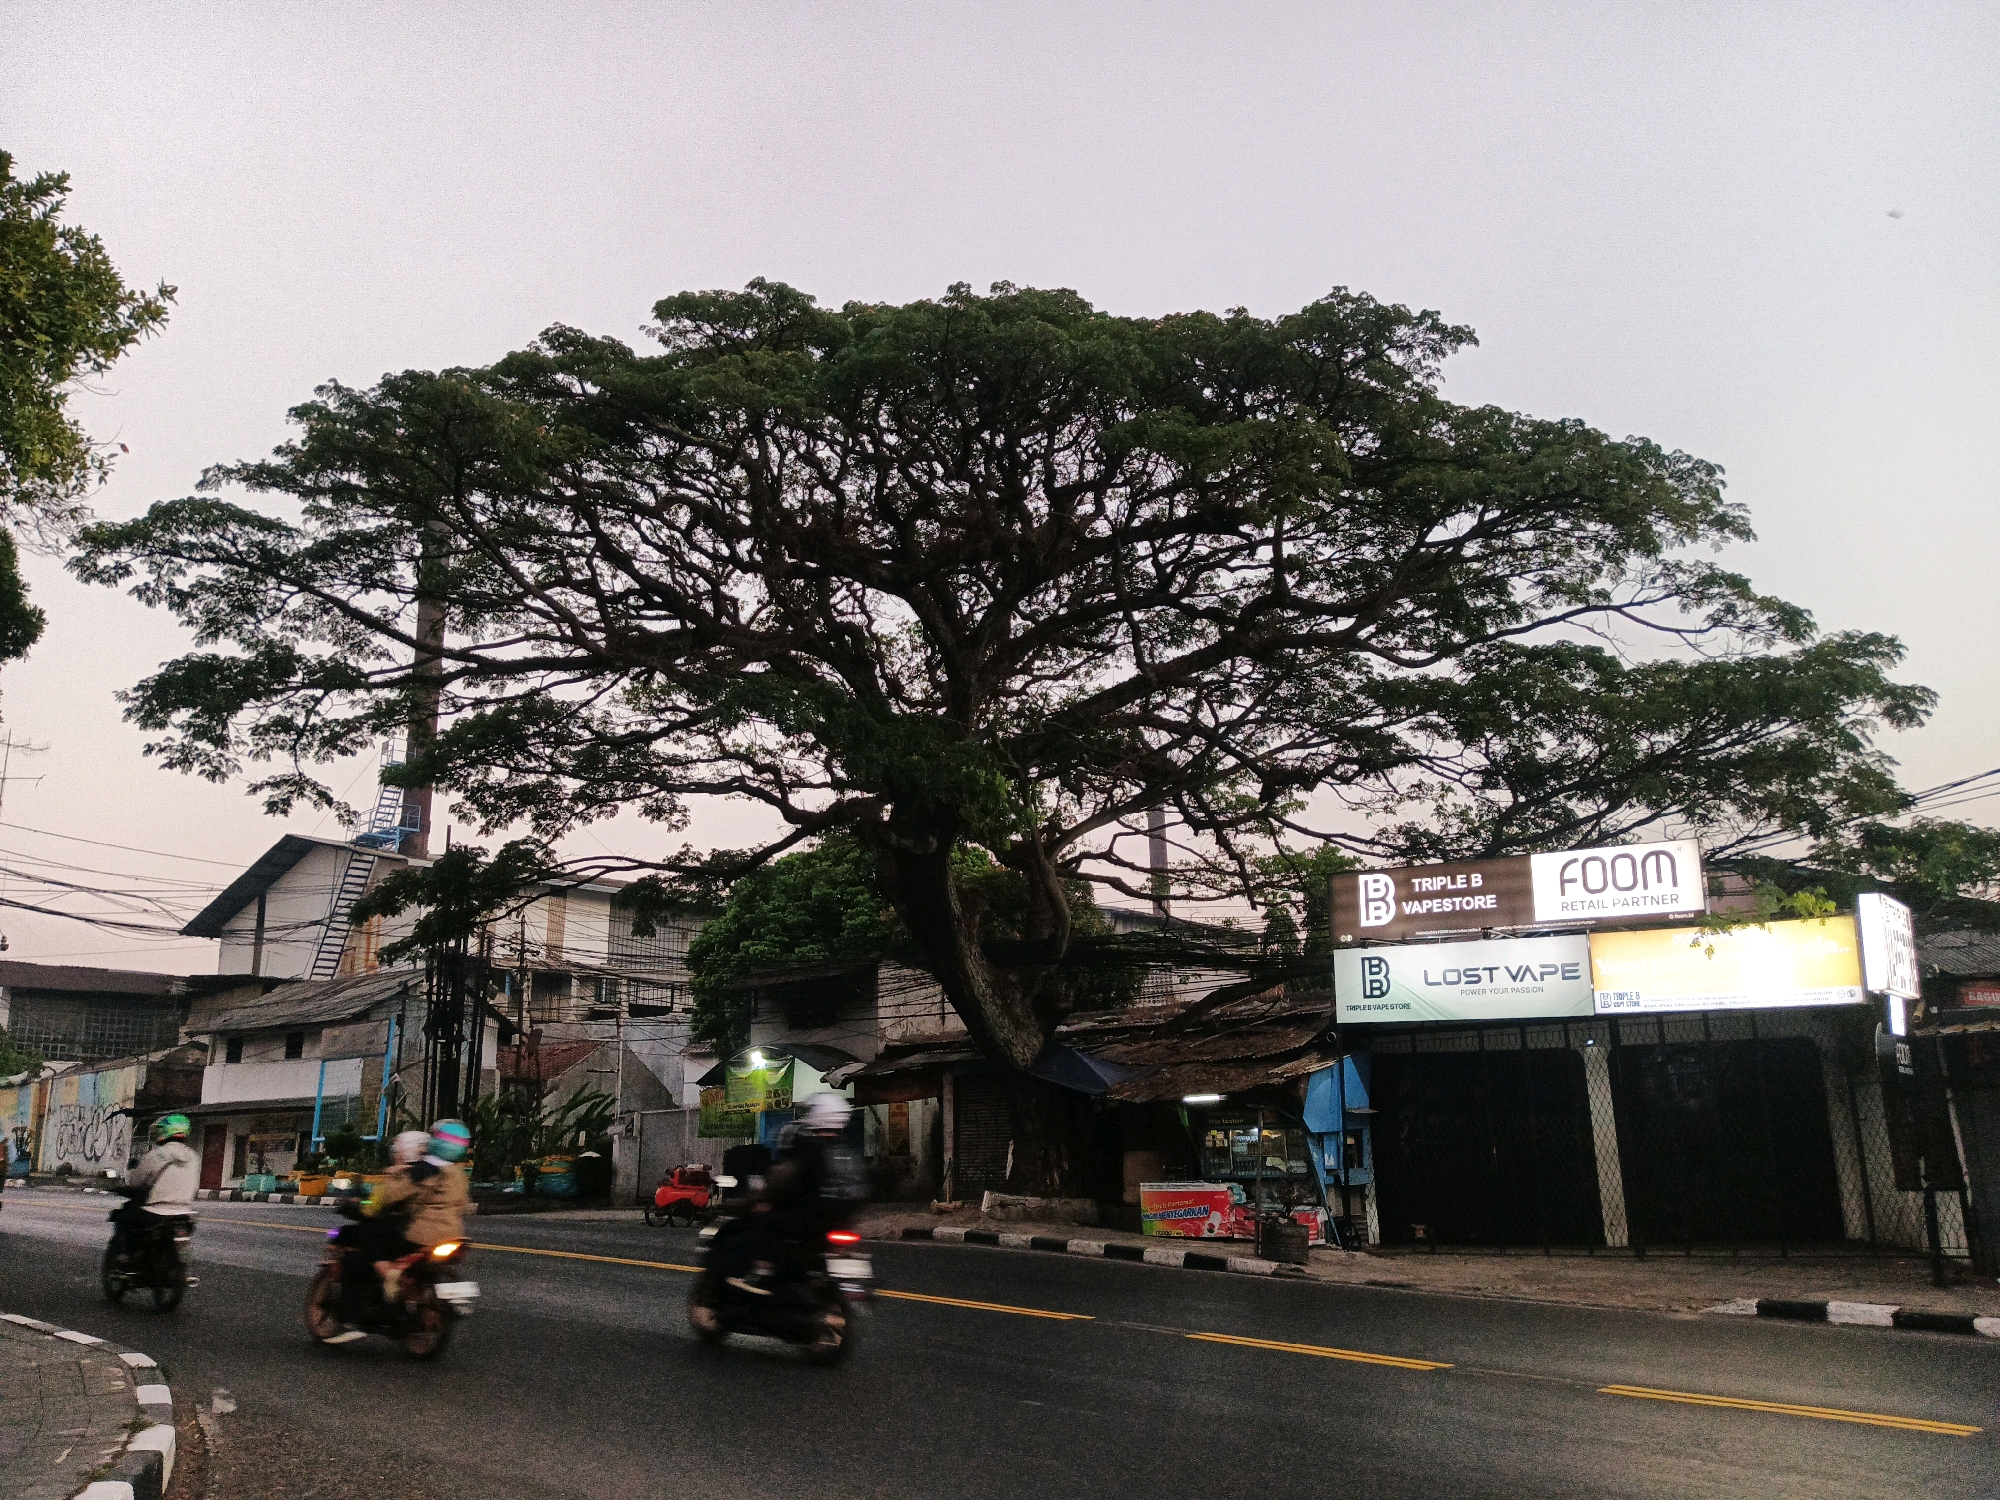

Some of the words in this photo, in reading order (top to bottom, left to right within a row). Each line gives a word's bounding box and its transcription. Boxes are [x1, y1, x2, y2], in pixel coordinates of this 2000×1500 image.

[1412, 874, 1468, 893] TRIPLE
[1471, 873, 1483, 888] B
[1559, 850, 1678, 896] FOOM
[1402, 894, 1497, 915] VAPESTORE
[1561, 899, 1609, 912] RETAIL
[1613, 893, 1680, 908] PARTNER
[1423, 966, 1500, 986] LOST
[1504, 962, 1581, 983] VAPE
[1460, 988, 1487, 996] POWER
[1488, 987, 1510, 995] YOUR
[1511, 986, 1544, 994] PASSION
[1158, 1205, 1209, 1219] MENYEGARKAN
